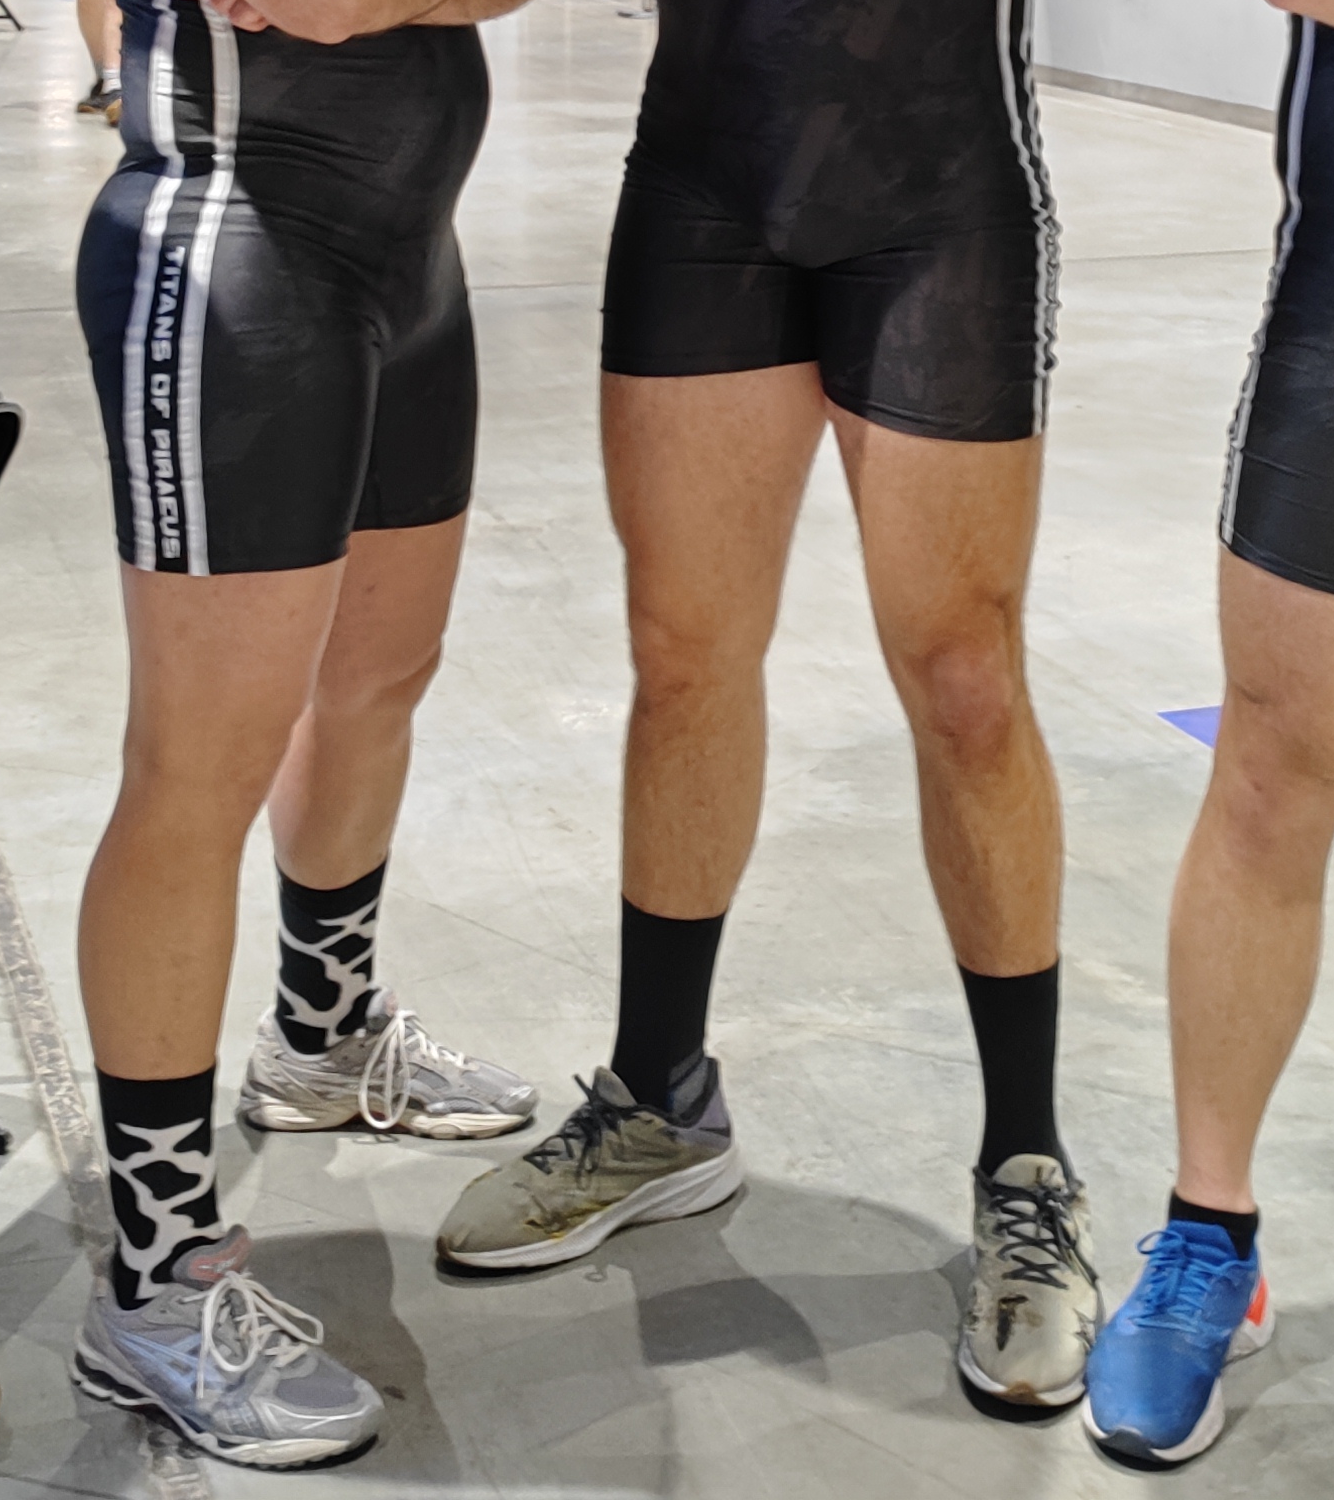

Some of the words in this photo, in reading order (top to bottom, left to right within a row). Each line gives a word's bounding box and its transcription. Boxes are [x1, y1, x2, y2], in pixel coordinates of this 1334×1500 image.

[150, 246, 186, 362] TITANS
[150, 372, 171, 419] OF
[150, 428, 183, 560] PIRAEUS
